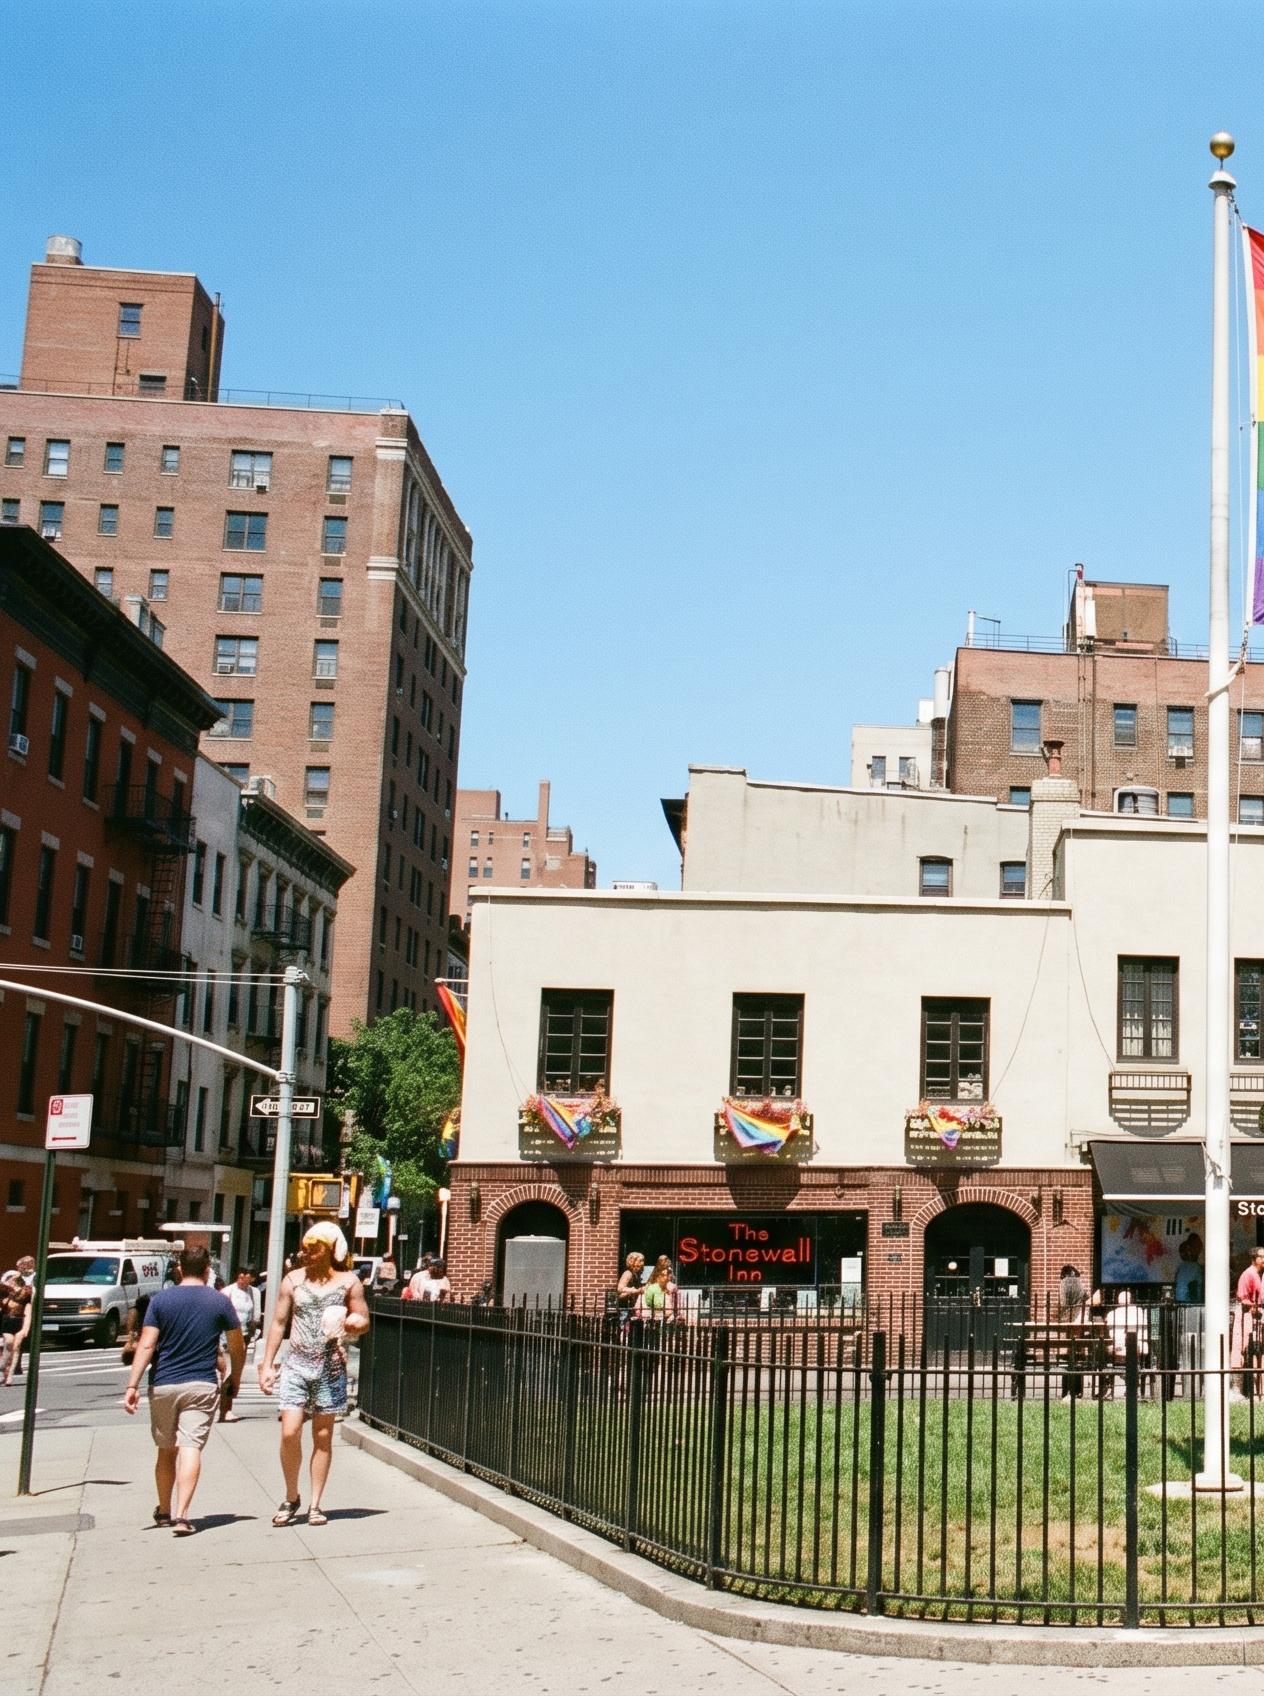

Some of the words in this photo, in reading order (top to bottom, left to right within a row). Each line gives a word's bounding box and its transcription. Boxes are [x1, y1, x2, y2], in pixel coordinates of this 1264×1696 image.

[728, 1223, 770, 1241] The
[678, 1237, 811, 1263] Stonewall
[729, 1264, 763, 1282] Inn
